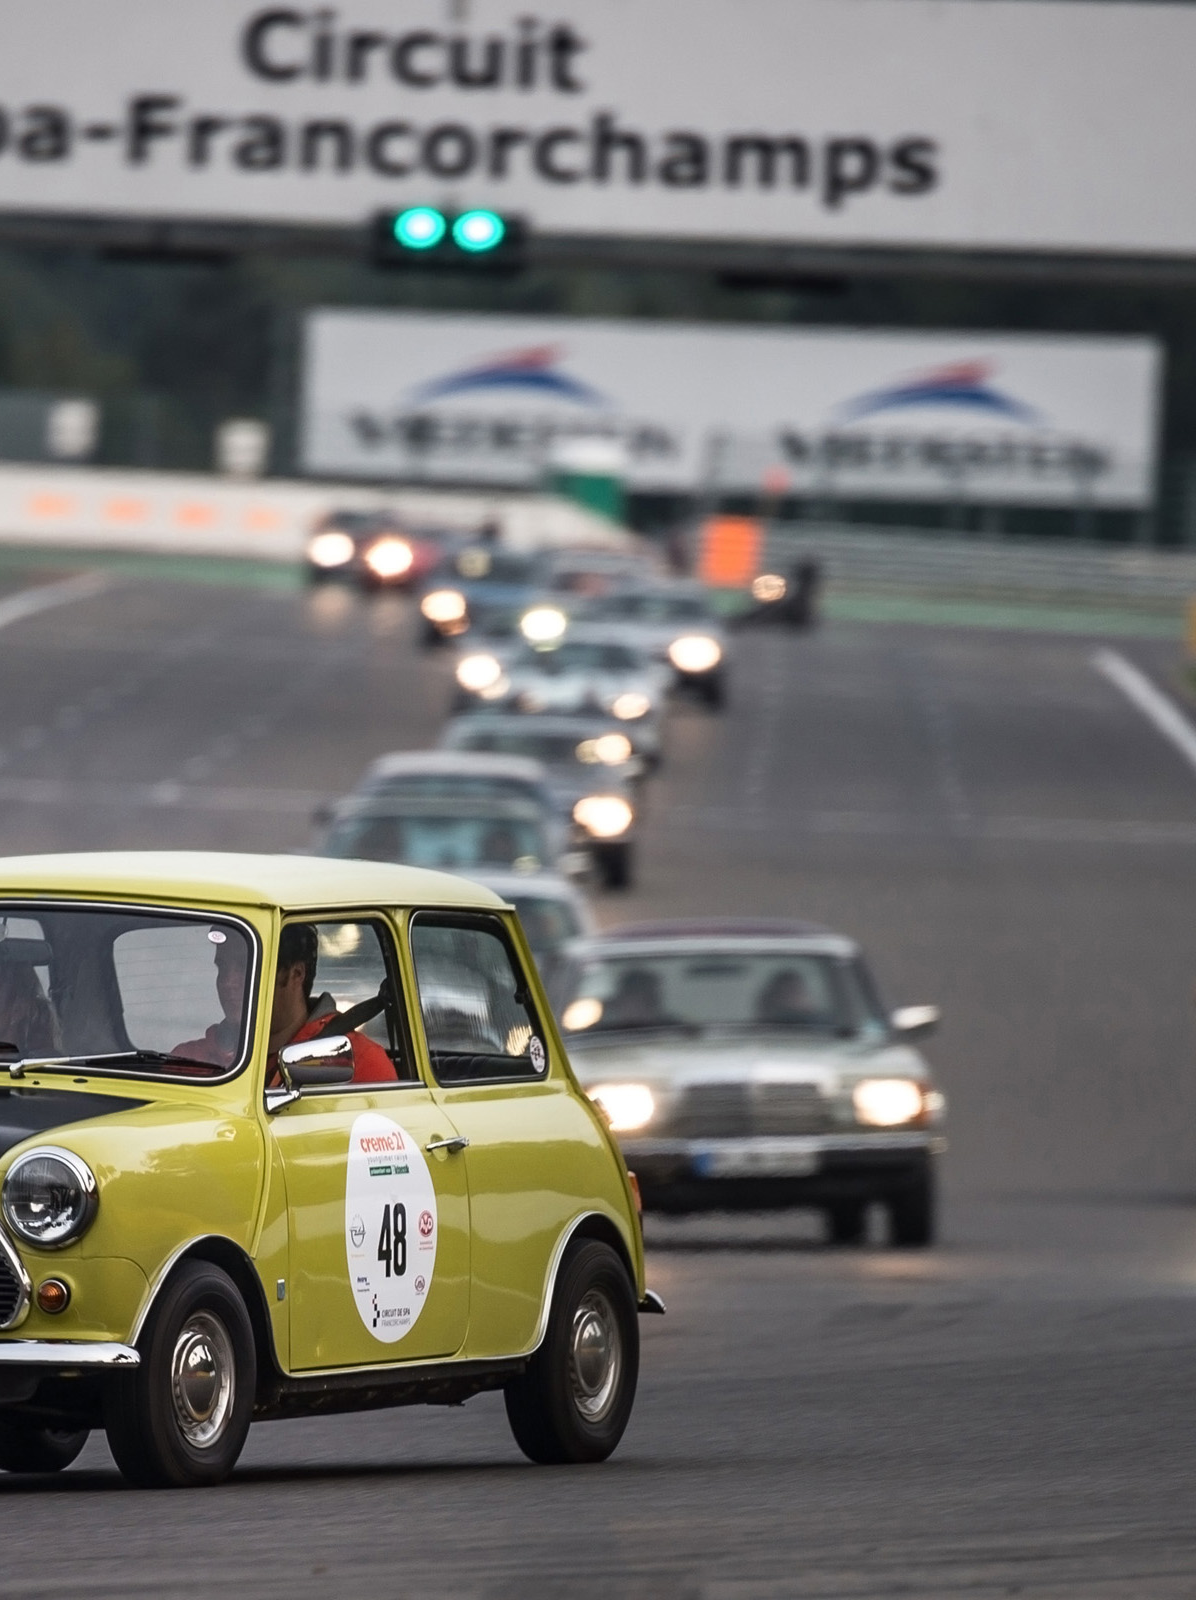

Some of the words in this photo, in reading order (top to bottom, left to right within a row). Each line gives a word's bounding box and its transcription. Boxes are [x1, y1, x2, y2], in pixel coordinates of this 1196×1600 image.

[242, 6, 587, 94] Circuit
[360, 1136, 395, 1153] creme
[377, 1202, 407, 1278] 48
[381, 1309, 397, 1318] CIRCUIT
[397, 1308, 403, 1317] DE
[403, 1307, 411, 1316] SPA
[381, 1317, 411, 1327] FRANCORCHAMPS
